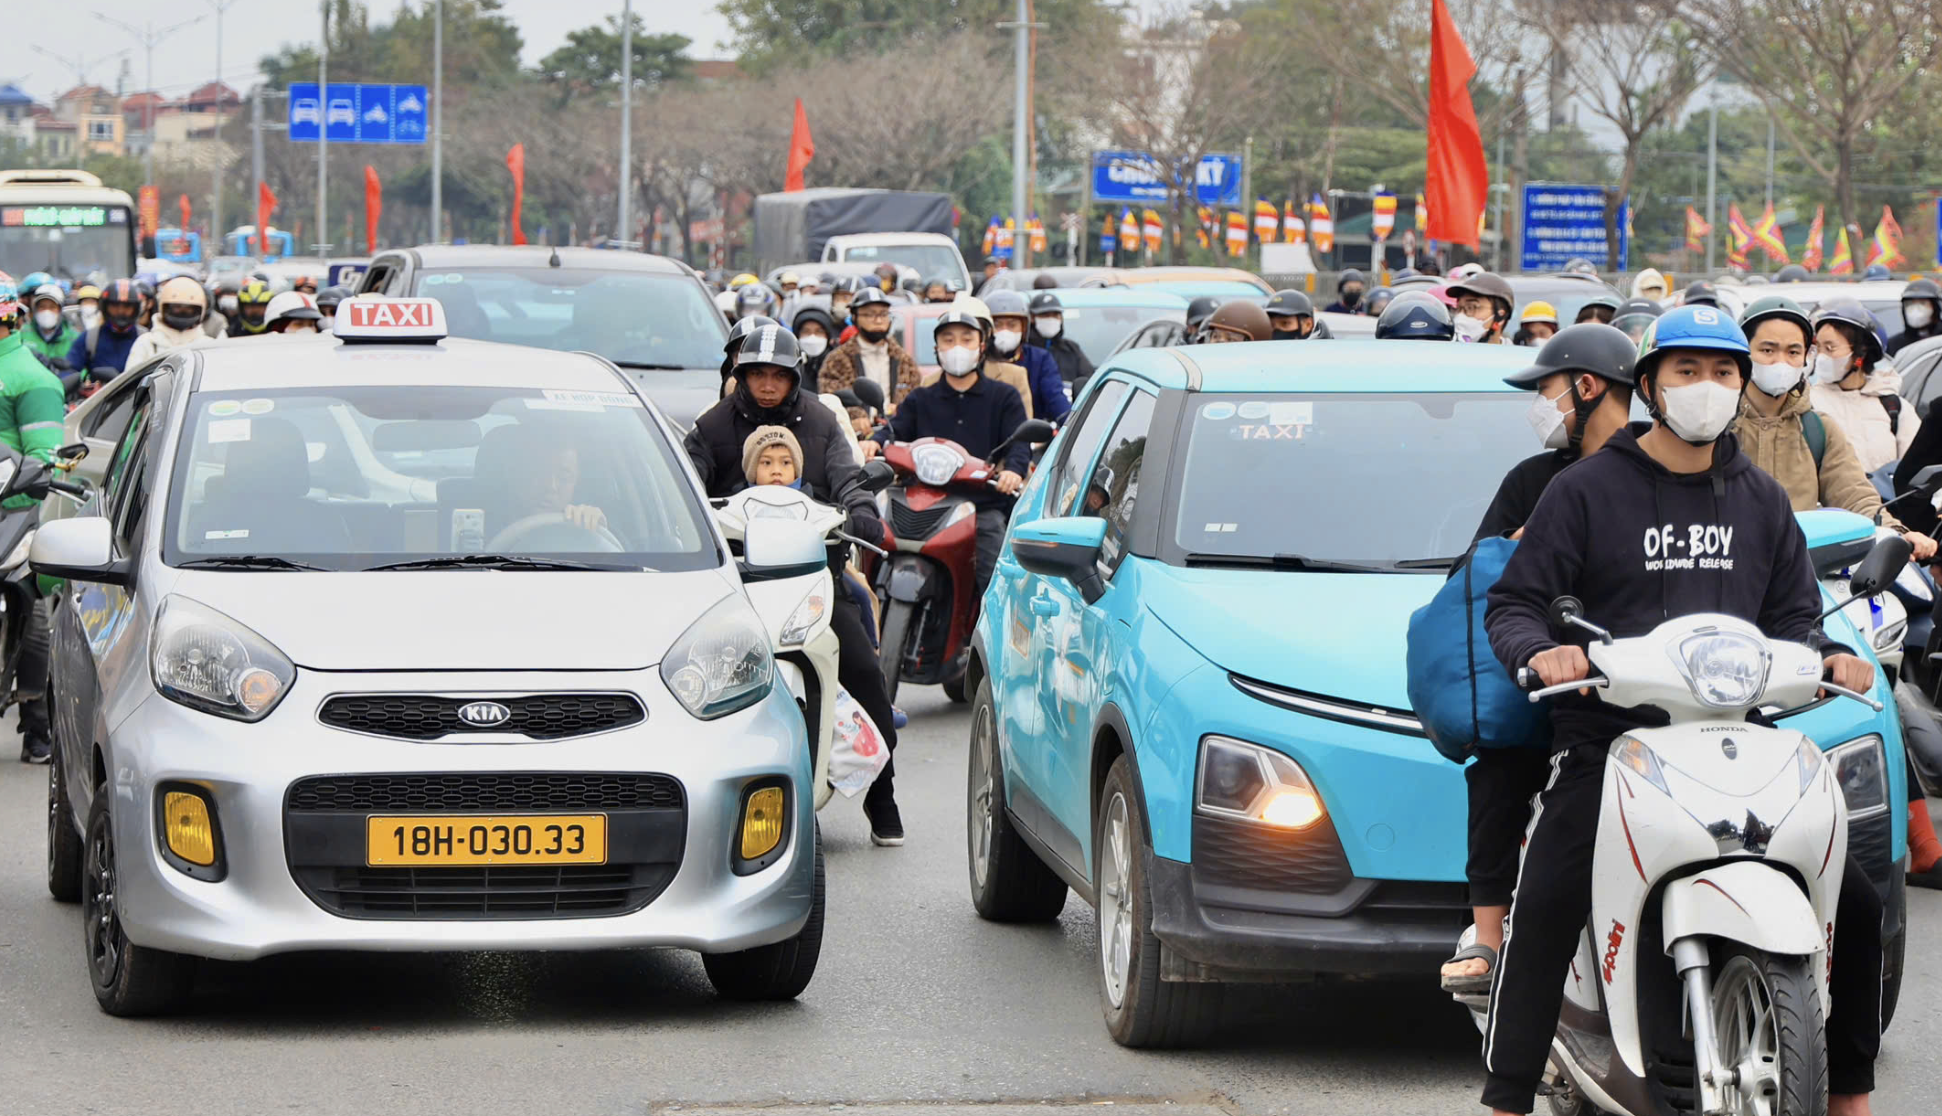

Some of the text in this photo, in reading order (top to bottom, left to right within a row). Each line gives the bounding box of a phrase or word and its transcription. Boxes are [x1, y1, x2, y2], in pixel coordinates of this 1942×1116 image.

[354, 304, 430, 325] TAXI
[1239, 425, 1305, 440] TAXI
[1643, 524, 1733, 557] OF-BOY
[467, 706, 502, 720] KIA
[393, 824, 585, 856] 18H-030.33
